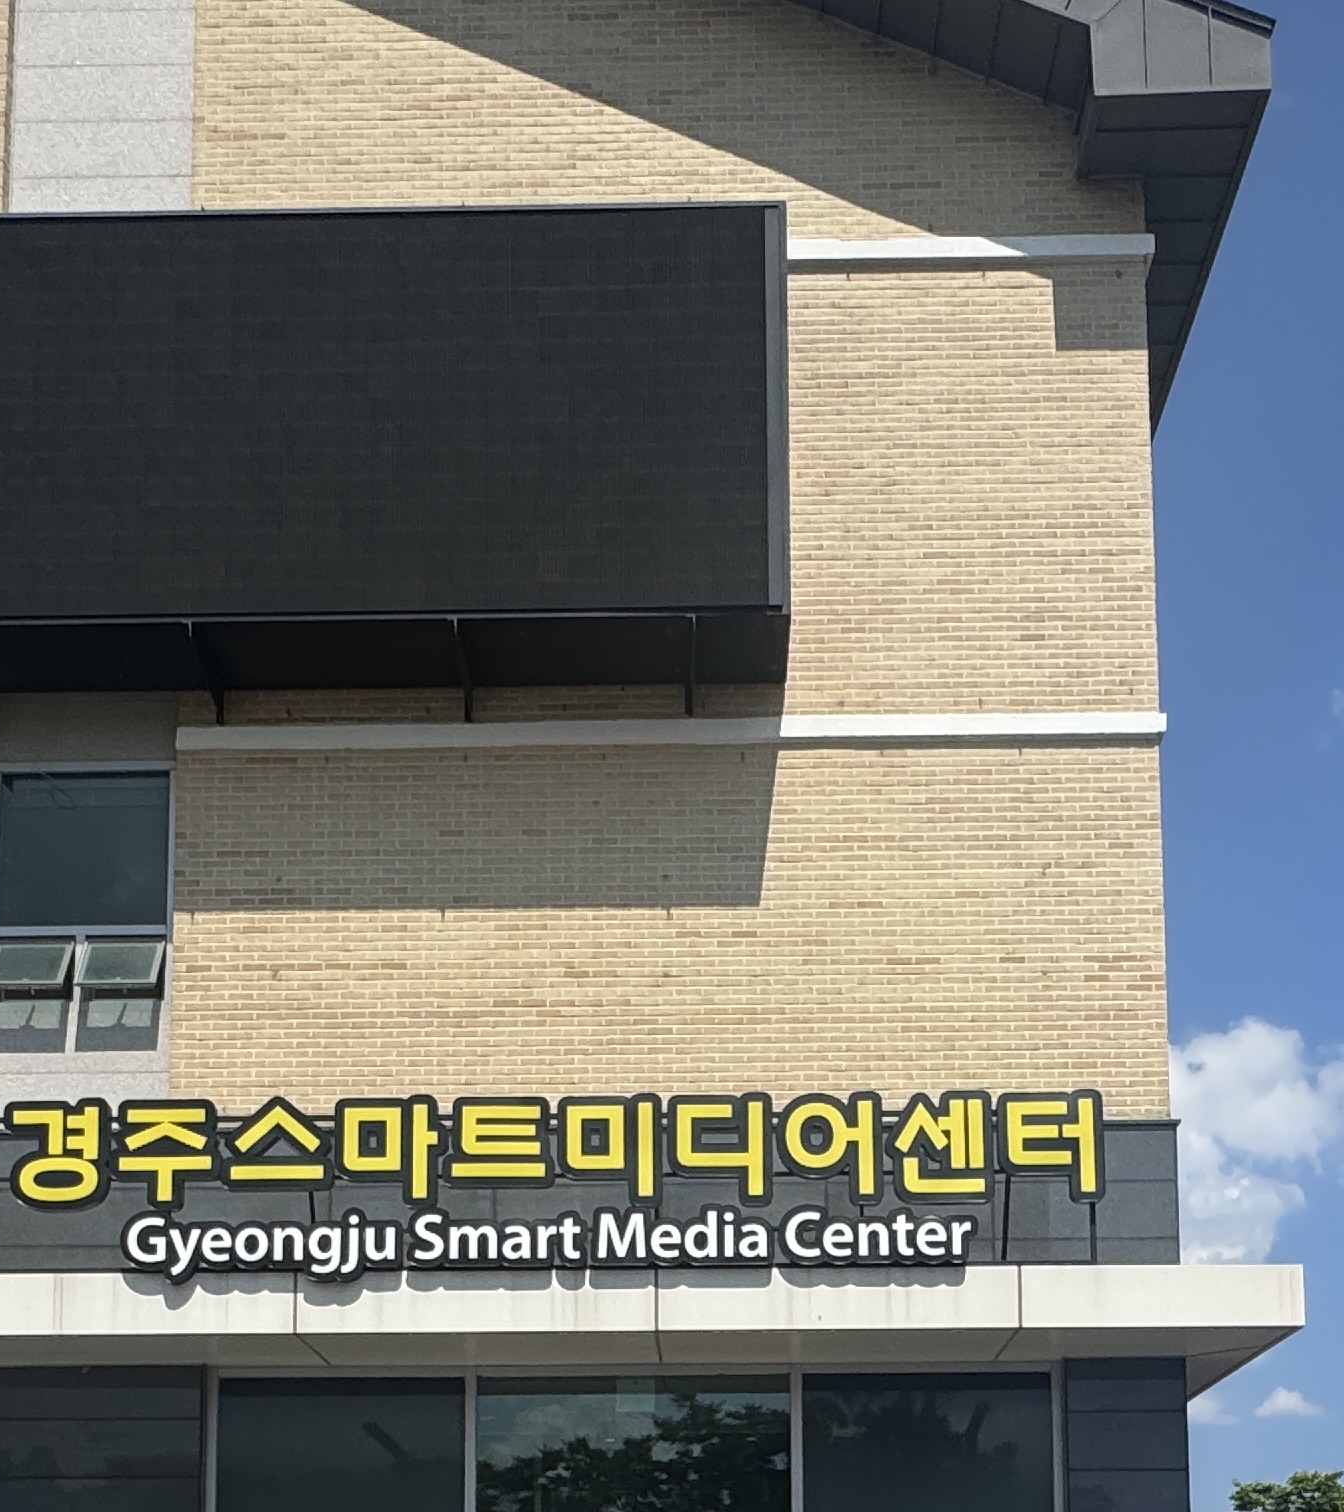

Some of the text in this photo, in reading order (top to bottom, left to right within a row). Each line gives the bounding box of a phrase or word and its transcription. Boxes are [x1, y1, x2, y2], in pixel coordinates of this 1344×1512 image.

[12, 1098, 1097, 1202] 경주스마트미디어센터
[127, 1209, 973, 1277] Gyeongju Smart Media Center
